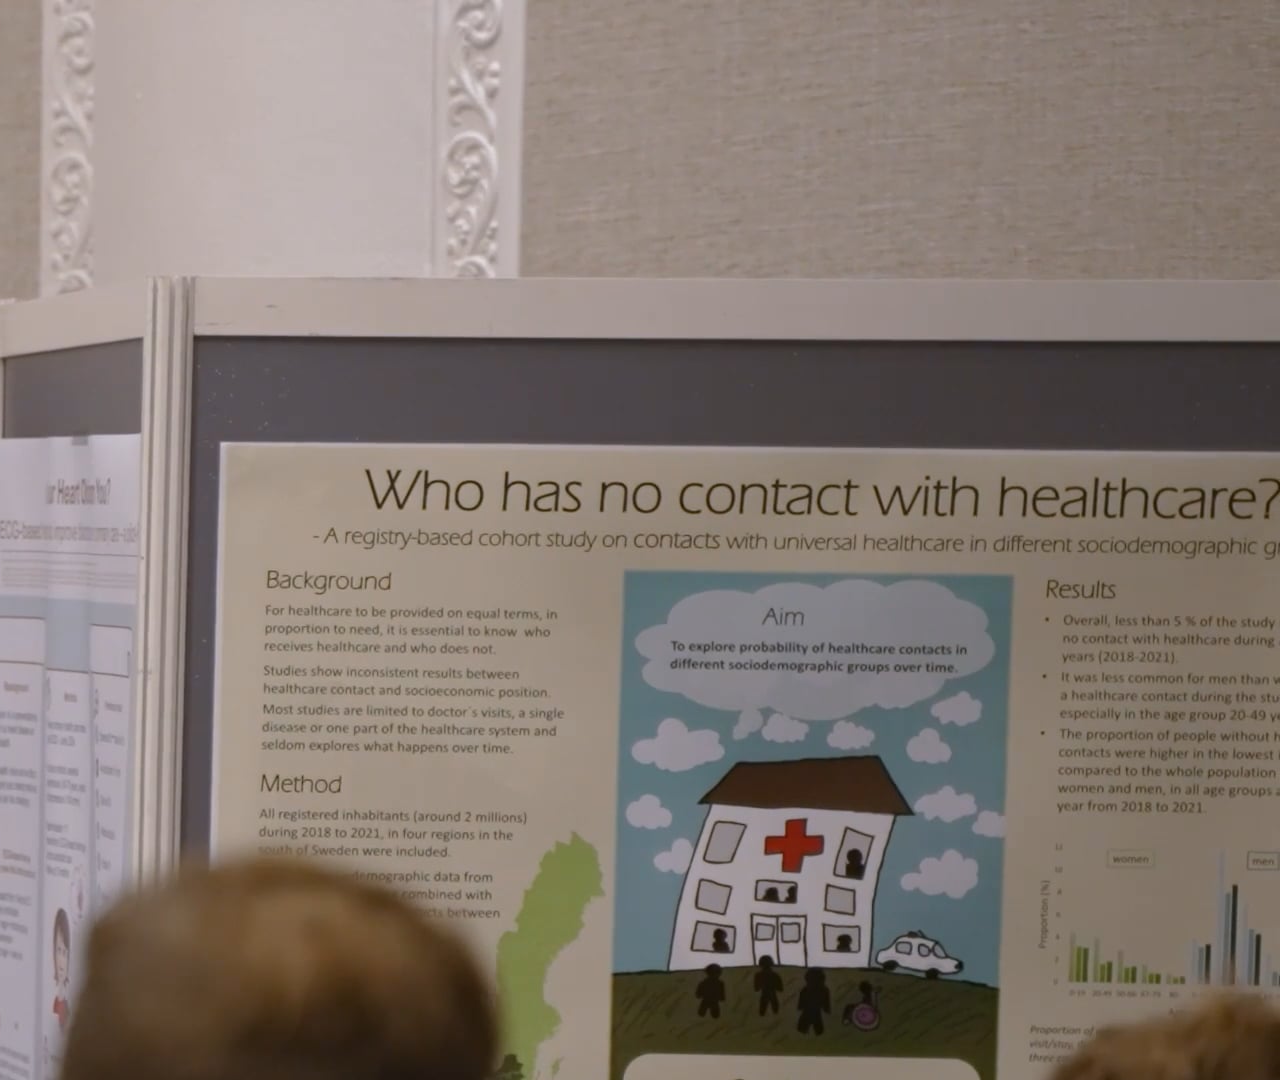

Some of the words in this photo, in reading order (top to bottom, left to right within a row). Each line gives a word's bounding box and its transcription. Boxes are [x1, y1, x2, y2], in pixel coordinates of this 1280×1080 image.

[365, 469, 484, 511] Who
[502, 471, 582, 513] has
[600, 481, 662, 514] no
[679, 478, 860, 516] contact
[873, 475, 979, 517] with
[999, 476, 1280, 520] healthcare?
[323, 527, 339, 544] A
[345, 527, 473, 551] registry-based
[478, 529, 541, 547] cohort
[546, 530, 597, 552] study
[602, 534, 628, 548] on
[633, 531, 720, 549] contacts
[726, 532, 767, 550] with
[774, 533, 856, 551] universal
[863, 534, 964, 552] healthcare
[970, 536, 987, 552] in
[993, 535, 1072, 553] different
[1077, 536, 1258, 560] sociodemographic
[267, 570, 392, 594] Background
[1046, 579, 1116, 599] Results
[265, 604, 285, 616] For
[288, 604, 352, 617] healthcare
[355, 608, 368, 617] to
[372, 606, 386, 617] be
[390, 606, 444, 620] provided
[447, 610, 463, 618] on
[466, 608, 500, 620] equal
[504, 609, 542, 621] terms,
[546, 609, 558, 619] in
[762, 608, 805, 626] Aim
[265, 623, 330, 637] proportion
[334, 625, 346, 634] to
[349, 624, 383, 637] need,
[387, 625, 395, 636] it
[398, 624, 408, 636] is
[411, 624, 464, 637] essential
[468, 627, 481, 637] to
[484, 625, 517, 637] know
[524, 626, 551, 637] who
[1064, 614, 1110, 628] Overall,
[1115, 615, 1138, 626] less
[1142, 615, 1170, 626] than
[1174, 616, 1181, 627] 5
[1185, 616, 1197, 627] %
[1200, 616, 1213, 627] of
[1217, 616, 1237, 628] the
[1241, 617, 1275, 630] study
[671, 640, 685, 651] To
[688, 640, 736, 655] explore
[739, 641, 808, 655] probability
[812, 642, 825, 654] of
[828, 643, 895, 654] healthcare
[899, 644, 952, 655] contacts
[956, 645, 967, 655] in
[670, 658, 725, 670] different
[729, 659, 843, 674] sociodemographic
[847, 663, 890, 675] groups
[894, 664, 922, 672] over
[926, 662, 957, 673] time.
[261, 774, 342, 794] Method
[259, 808, 275, 819] All
[278, 808, 339, 823] registered
[342, 809, 410, 822] inhabitants
[413, 811, 461, 824] (around
[464, 811, 471, 822] 2
[476, 811, 527, 825] millions)
